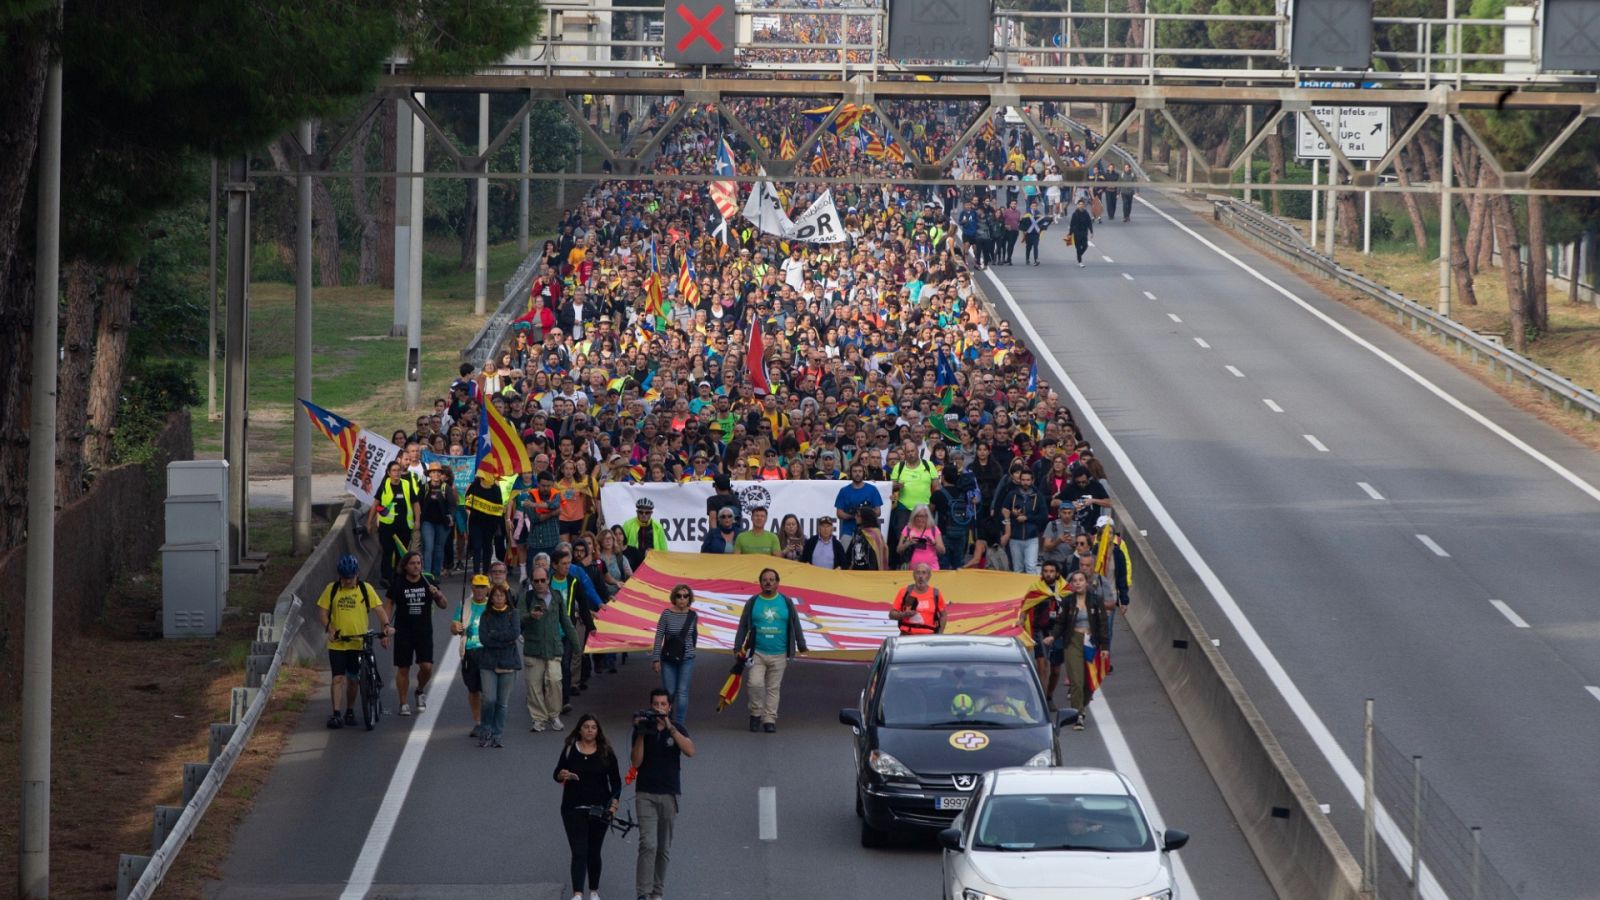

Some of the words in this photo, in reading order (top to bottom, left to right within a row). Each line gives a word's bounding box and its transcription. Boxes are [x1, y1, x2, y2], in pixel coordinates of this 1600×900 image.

[1340, 131, 1361, 140] UPC
[1348, 142, 1365, 151] Ral
[943, 798, 967, 808] 9997
